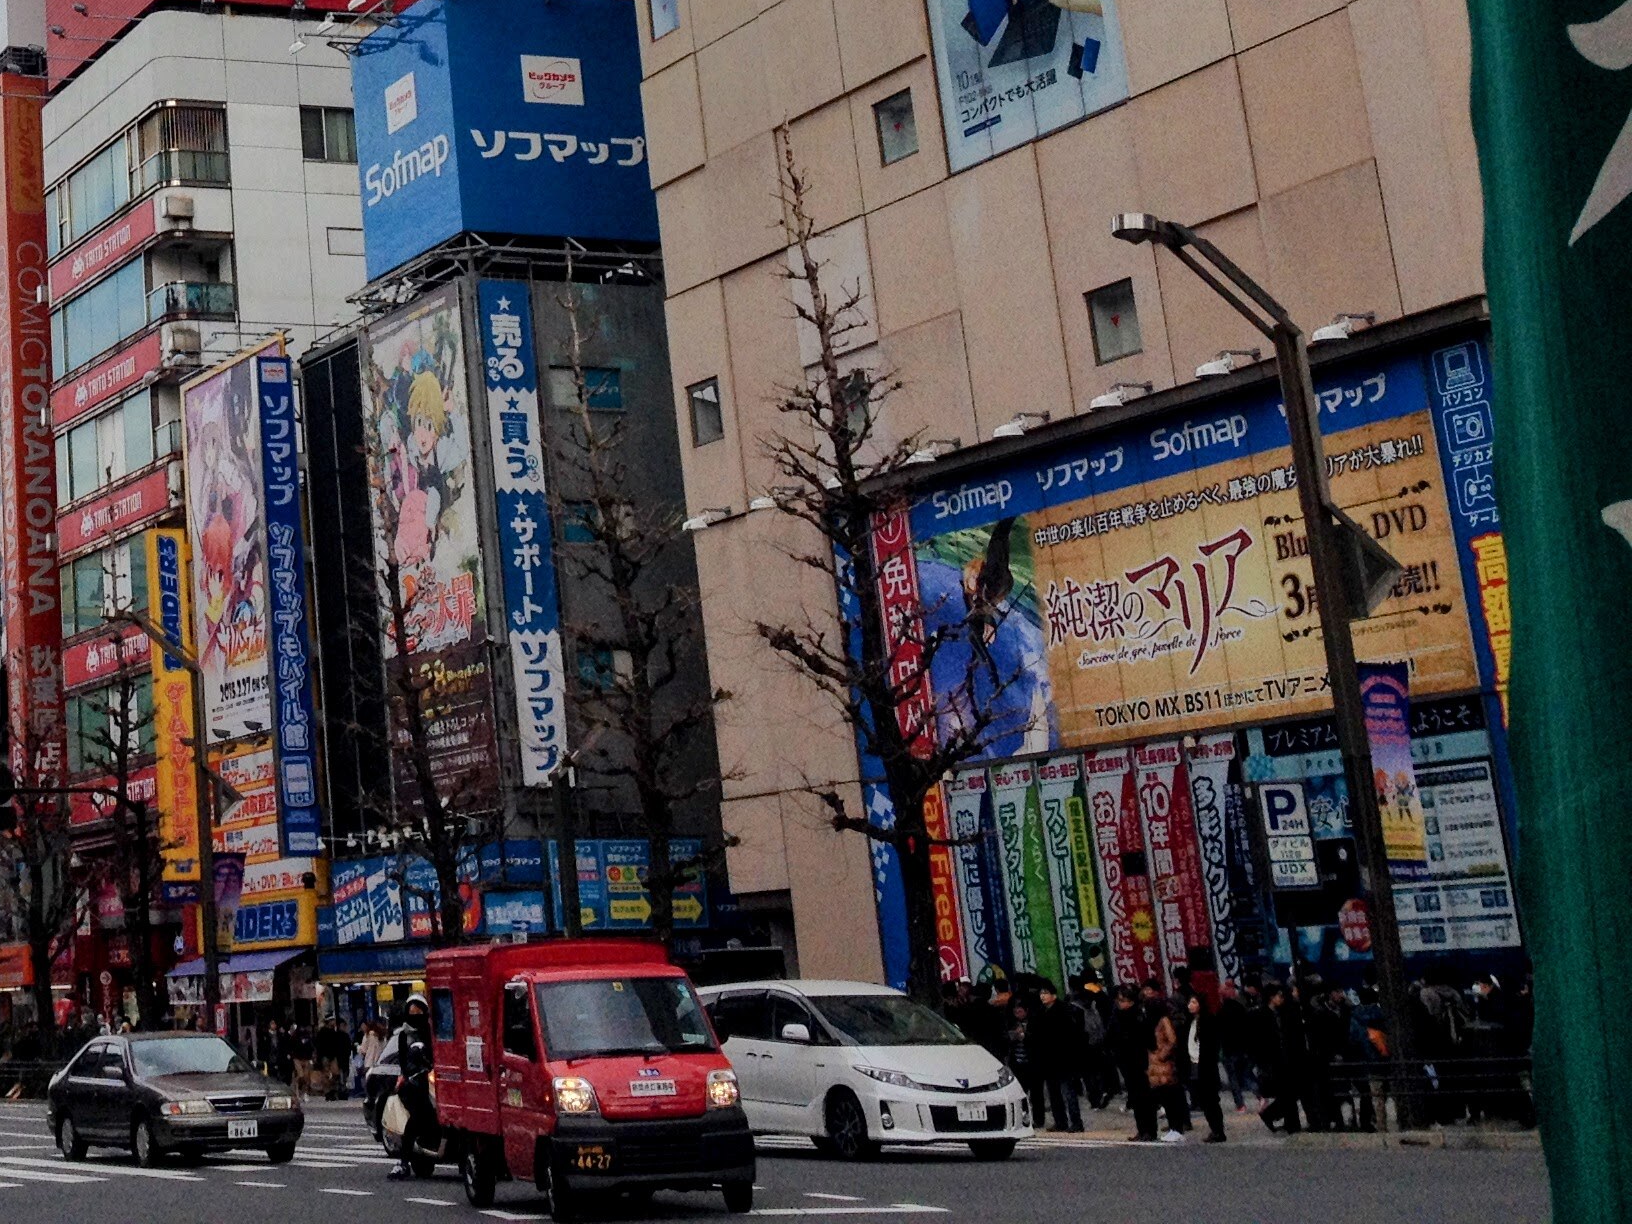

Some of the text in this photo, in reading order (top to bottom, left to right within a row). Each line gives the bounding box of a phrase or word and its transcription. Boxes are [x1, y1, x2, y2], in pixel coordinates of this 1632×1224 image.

[470, 129, 646, 166] ソフマップ
[365, 134, 450, 207] Sofmap
[263, 395, 295, 506] ソフマップ
[1149, 413, 1248, 462] Sofmap
[1035, 446, 1125, 491] ソフマップ
[931, 478, 1013, 520] Sofmap
[1370, 503, 1428, 539] DVD
[510, 516, 542, 623] サポート
[1046, 525, 1254, 676] 純潔のマリア
[520, 640, 559, 773] ソフマップ
[1095, 703, 1150, 726] TOKYO
[1264, 789, 1297, 831] P
[1281, 819, 1304, 831] 24H
[1279, 863, 1307, 875] UDX
